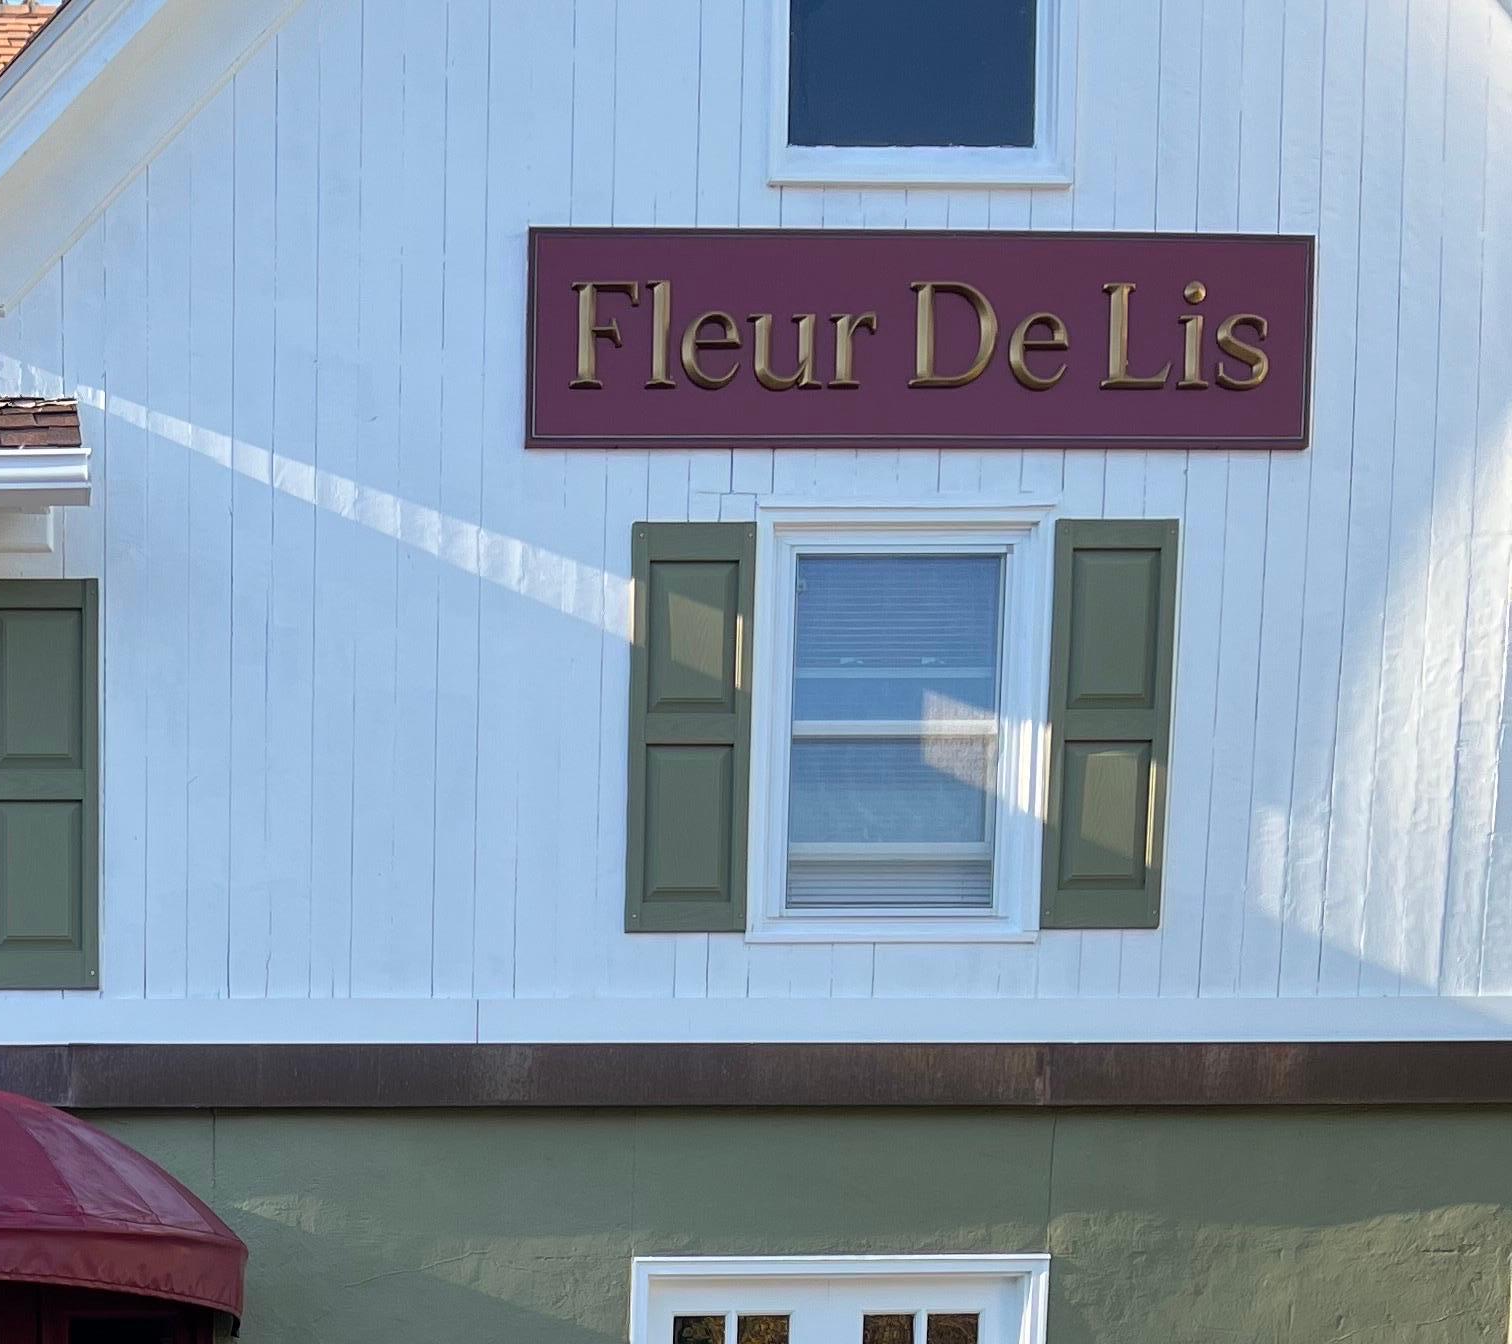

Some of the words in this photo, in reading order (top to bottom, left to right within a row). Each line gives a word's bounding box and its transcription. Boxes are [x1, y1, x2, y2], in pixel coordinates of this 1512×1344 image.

[568, 279, 878, 392] Fleur
[907, 280, 1070, 392] De
[1098, 280, 1271, 392] Lis
